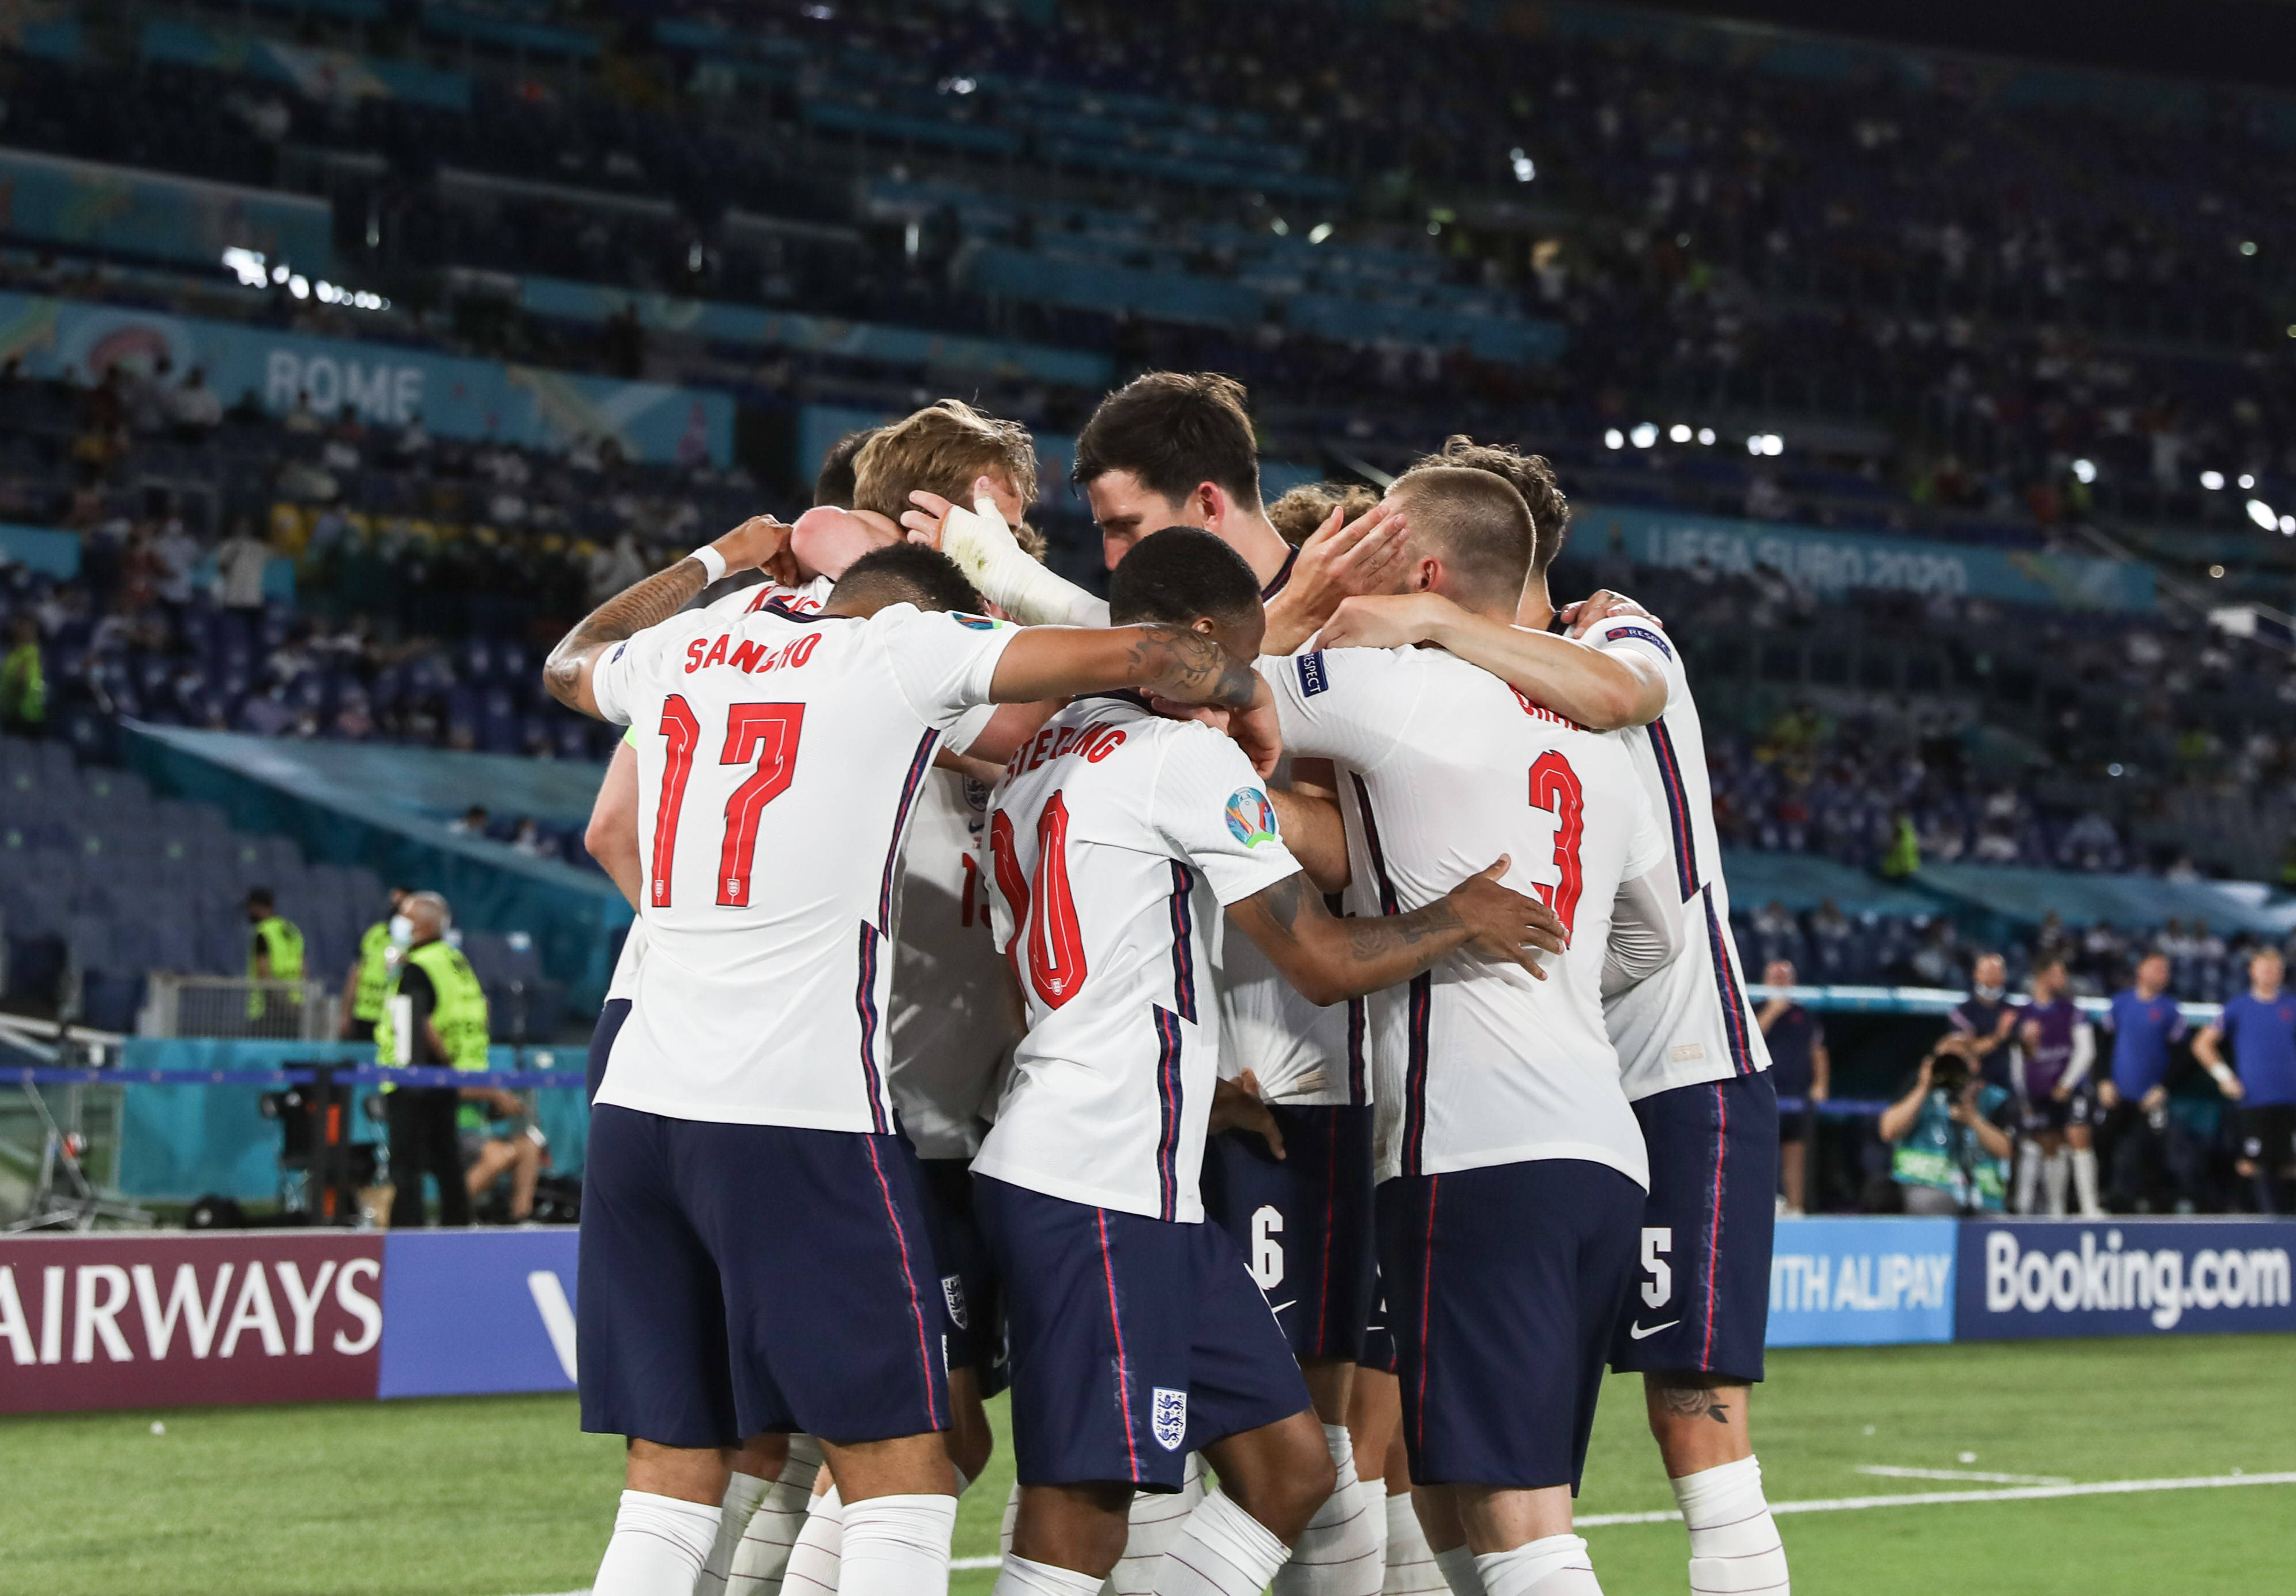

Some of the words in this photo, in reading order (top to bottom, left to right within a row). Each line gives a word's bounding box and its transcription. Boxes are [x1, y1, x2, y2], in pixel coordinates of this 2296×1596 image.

[266, 349, 426, 424] ROME
[651, 693, 806, 908] 17
[961, 852, 992, 929] 1
[1528, 749, 1583, 951] 3
[990, 789, 1088, 1011] 10
[1251, 1206, 1284, 1290] 6
[1641, 1227, 1671, 1309] 5
[1832, 1253, 1952, 1311] ALIPAY
[1986, 1229, 2292, 1330] Booking.com
[0, 1257, 384, 1365] AIRWAYS
